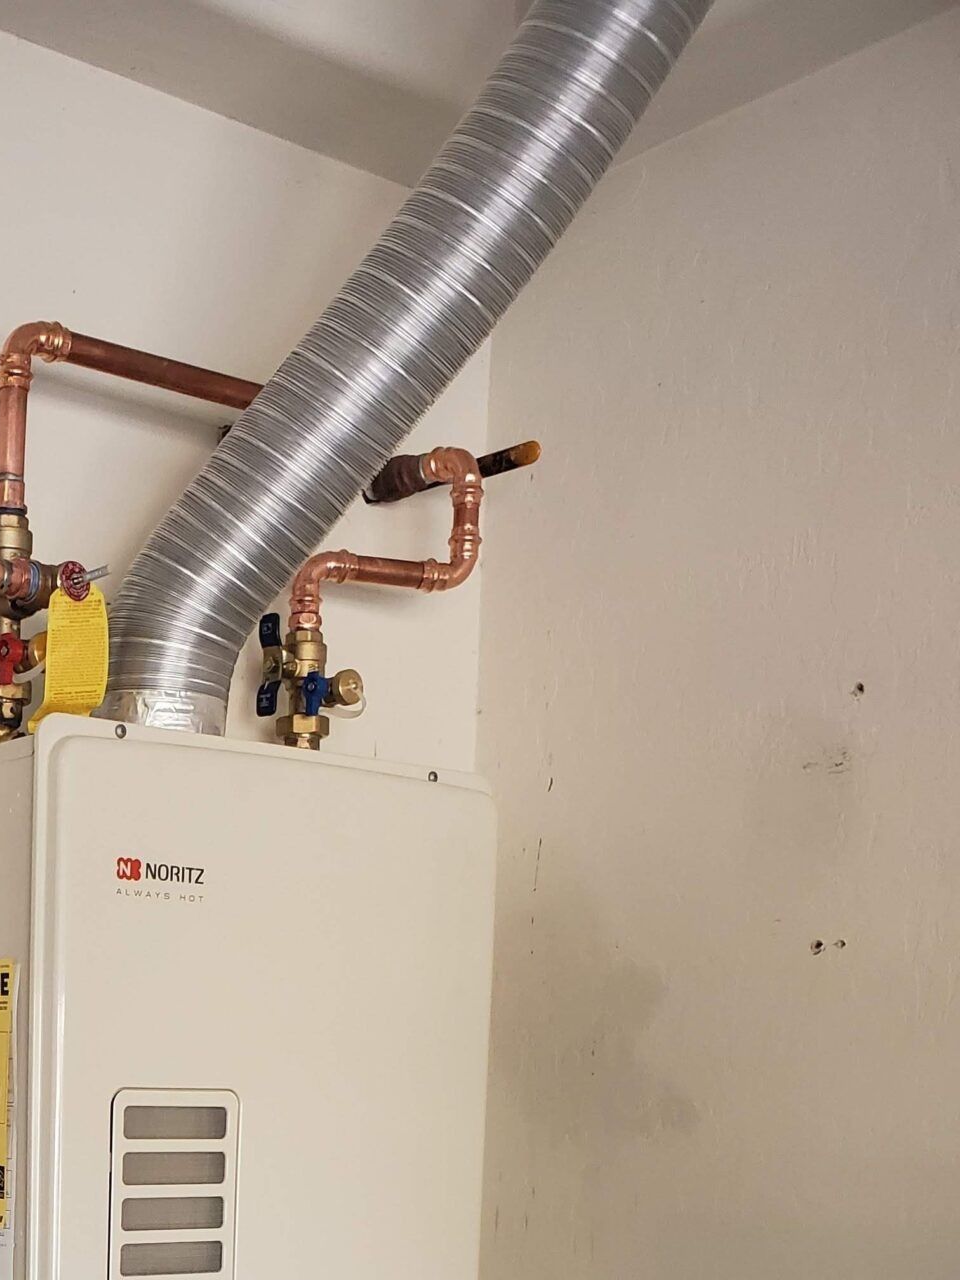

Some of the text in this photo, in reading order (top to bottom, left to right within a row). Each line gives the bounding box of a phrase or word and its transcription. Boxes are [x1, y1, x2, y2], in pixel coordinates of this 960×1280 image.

[145, 863, 205, 884] NORITZ
[116, 888, 204, 902] ALWAYS HOT
